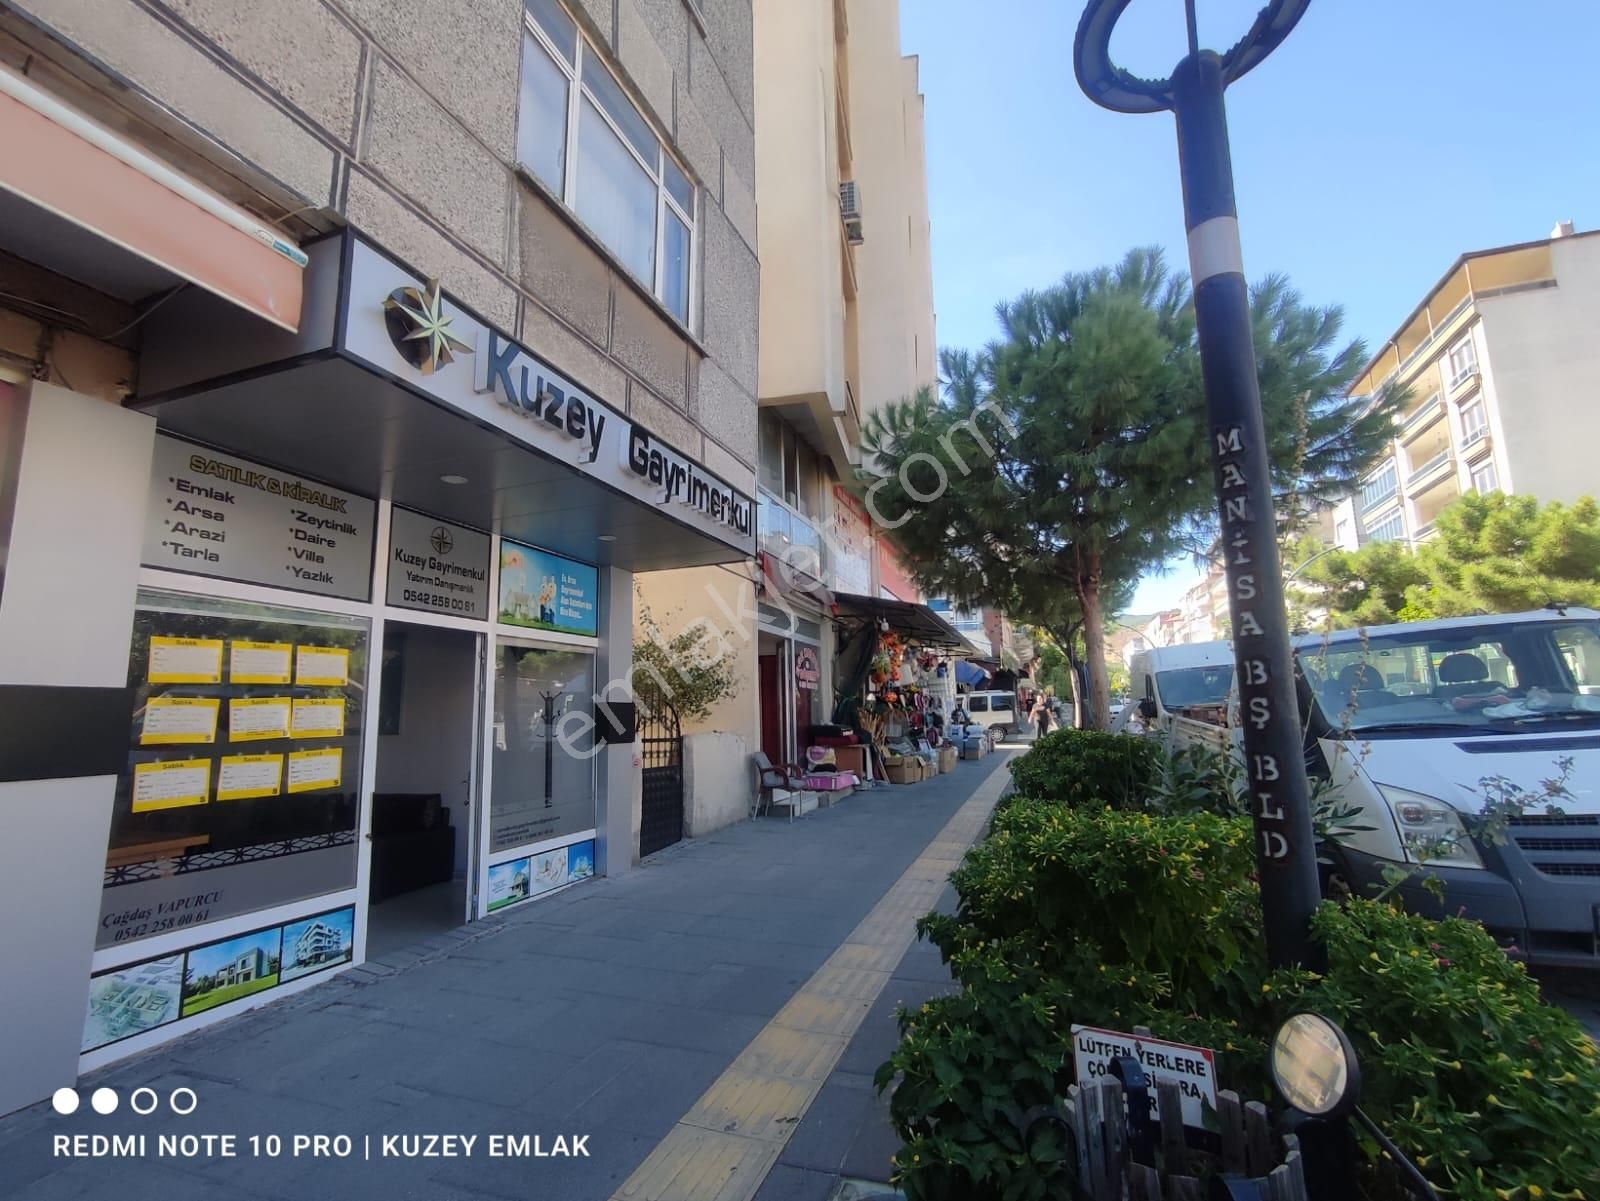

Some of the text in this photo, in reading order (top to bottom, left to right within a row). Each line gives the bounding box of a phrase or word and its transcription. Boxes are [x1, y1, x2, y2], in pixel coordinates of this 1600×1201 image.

[476, 327, 605, 464] Kuzey
[627, 423, 752, 537] Gayrimenkul
[395, 547, 485, 581] Kuzey Gayrimenkul
[403, 589, 430, 605] 0542
[102, 890, 224, 928] Çağdaş VAPURCU
[114, 909, 210, 941] 0542 258 00 61
[1079, 1036, 1206, 1077] LÜTFEN YERLERE
[1088, 1059, 1201, 1099] ÇÖ SİRA
